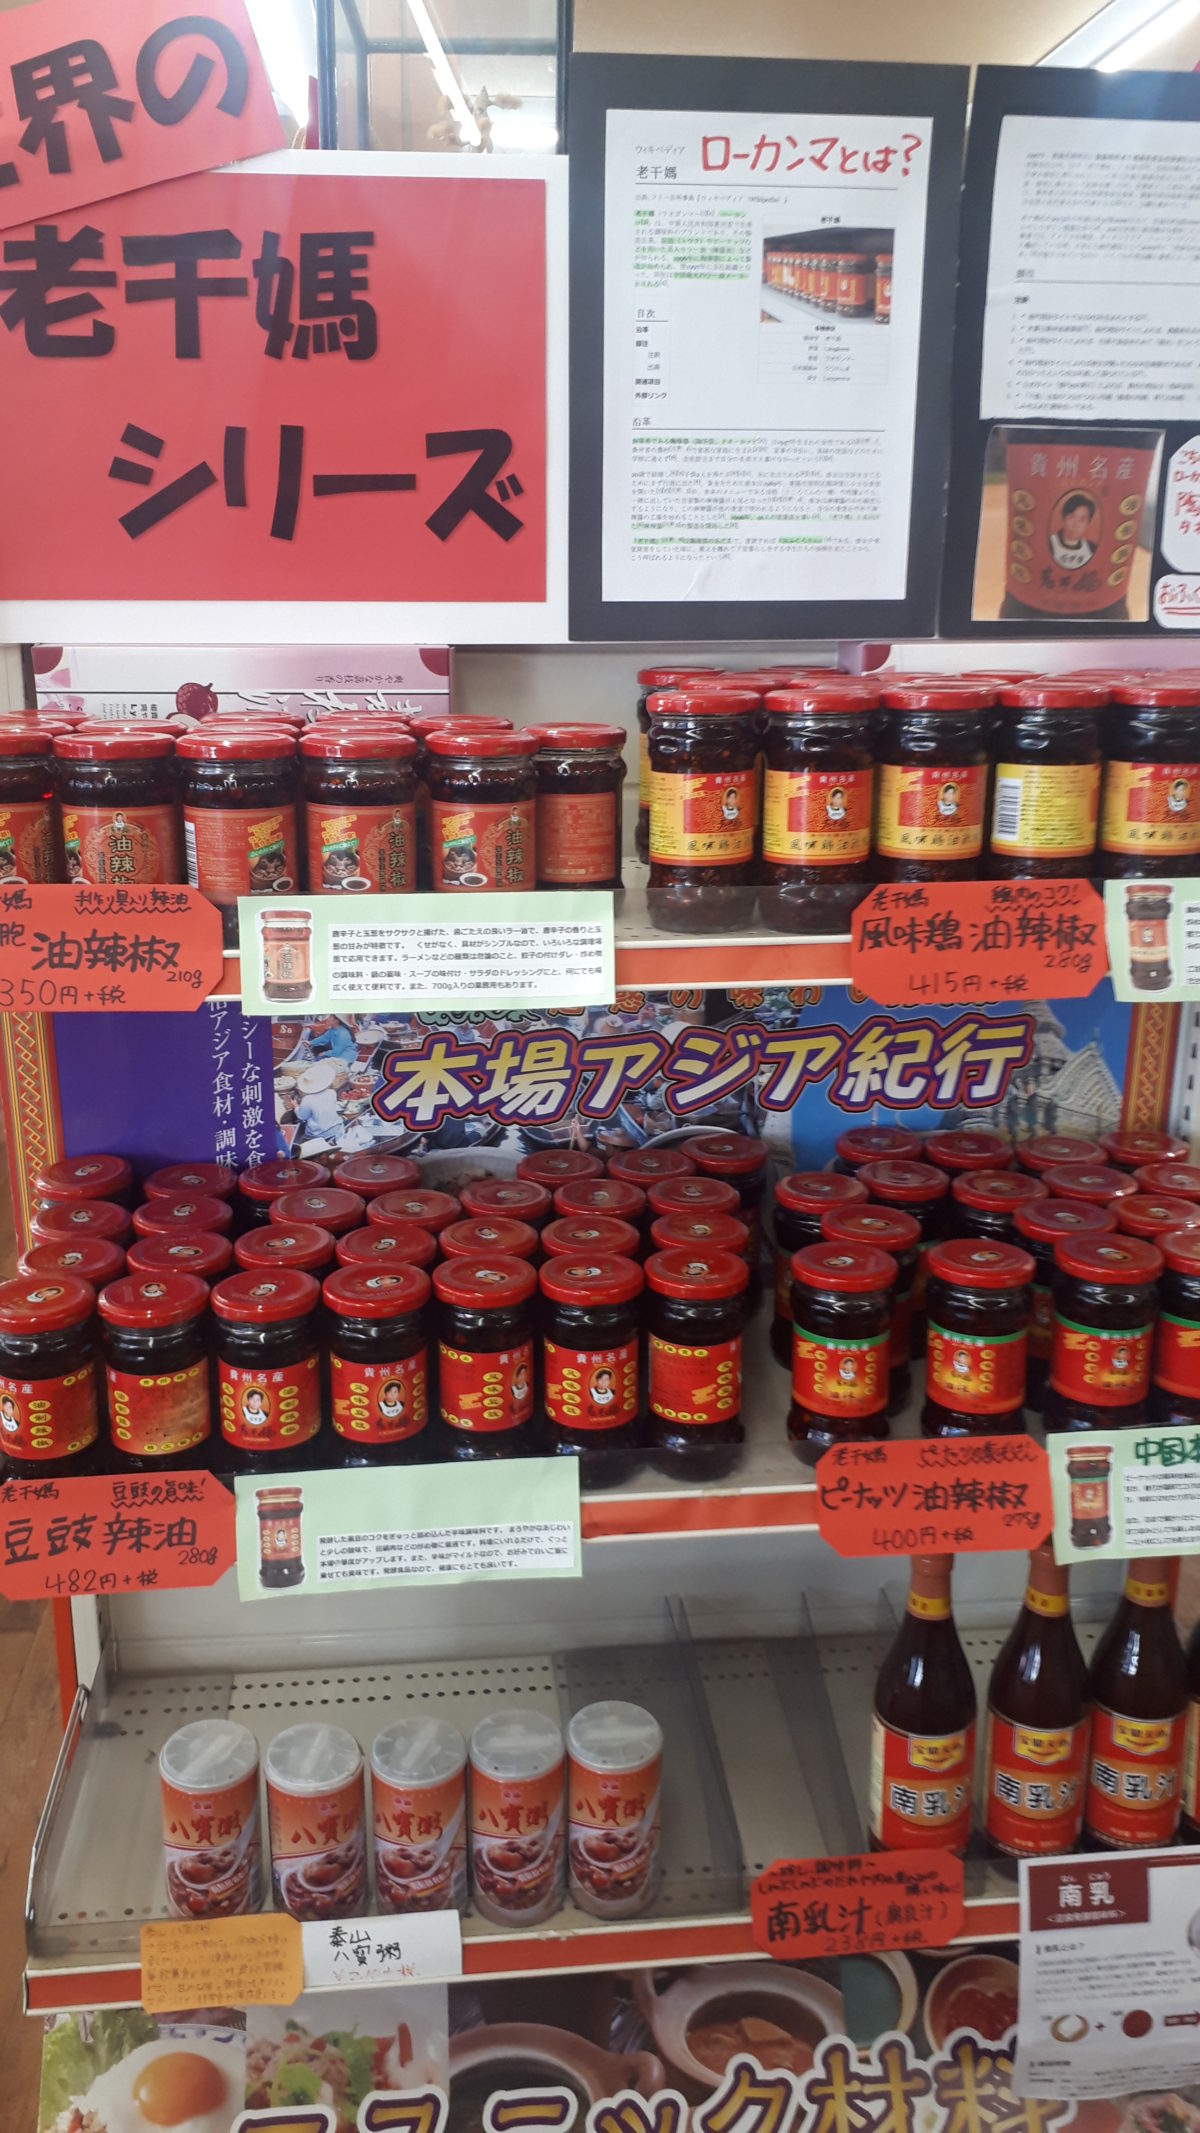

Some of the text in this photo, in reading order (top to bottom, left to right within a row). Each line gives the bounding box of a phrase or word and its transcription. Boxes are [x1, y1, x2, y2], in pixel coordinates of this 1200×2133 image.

[0, 15, 249, 186] 界の
[701, 134, 922, 177] ローカンマとは?
[636, 309, 655, 319] 目次
[108, 423, 525, 542] シリーズ
[31, 929, 181, 973] 油辣椒
[166, 969, 203, 988] 210g
[379, 1021, 1027, 1126] 本場アジア紀行
[1058, 1881, 1115, 1909] 南乳
[329, 1926, 371, 1949] 泰山
